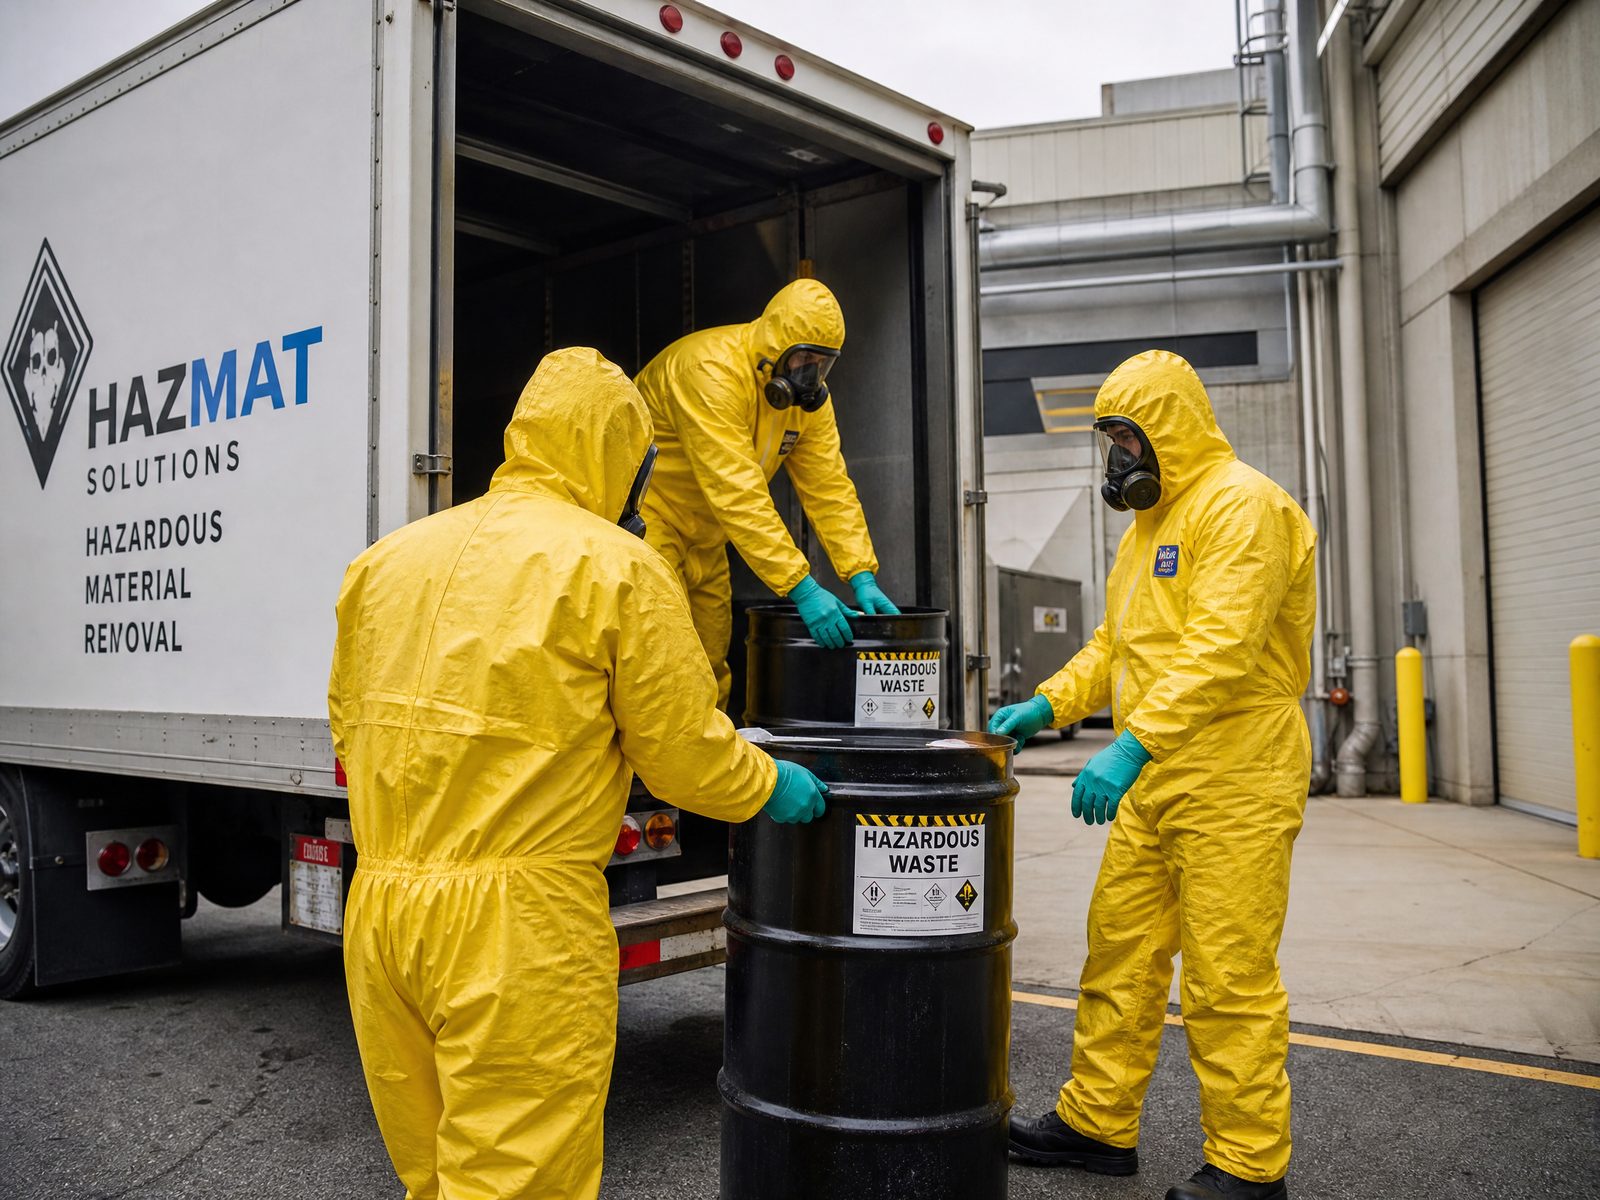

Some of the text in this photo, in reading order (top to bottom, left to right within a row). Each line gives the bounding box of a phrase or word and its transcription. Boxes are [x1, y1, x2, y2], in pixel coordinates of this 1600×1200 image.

[87, 325, 323, 449] HAZMAT
[86, 440, 240, 496] SOLUTIONS
[86, 509, 223, 557] HAZARDOUS
[85, 567, 192, 605] MATERIAL
[862, 662, 937, 676] HAZARDOUS
[880, 679, 925, 693] WASTE
[863, 829, 980, 849] HAZARDOUS
[888, 854, 959, 874] WASTE
